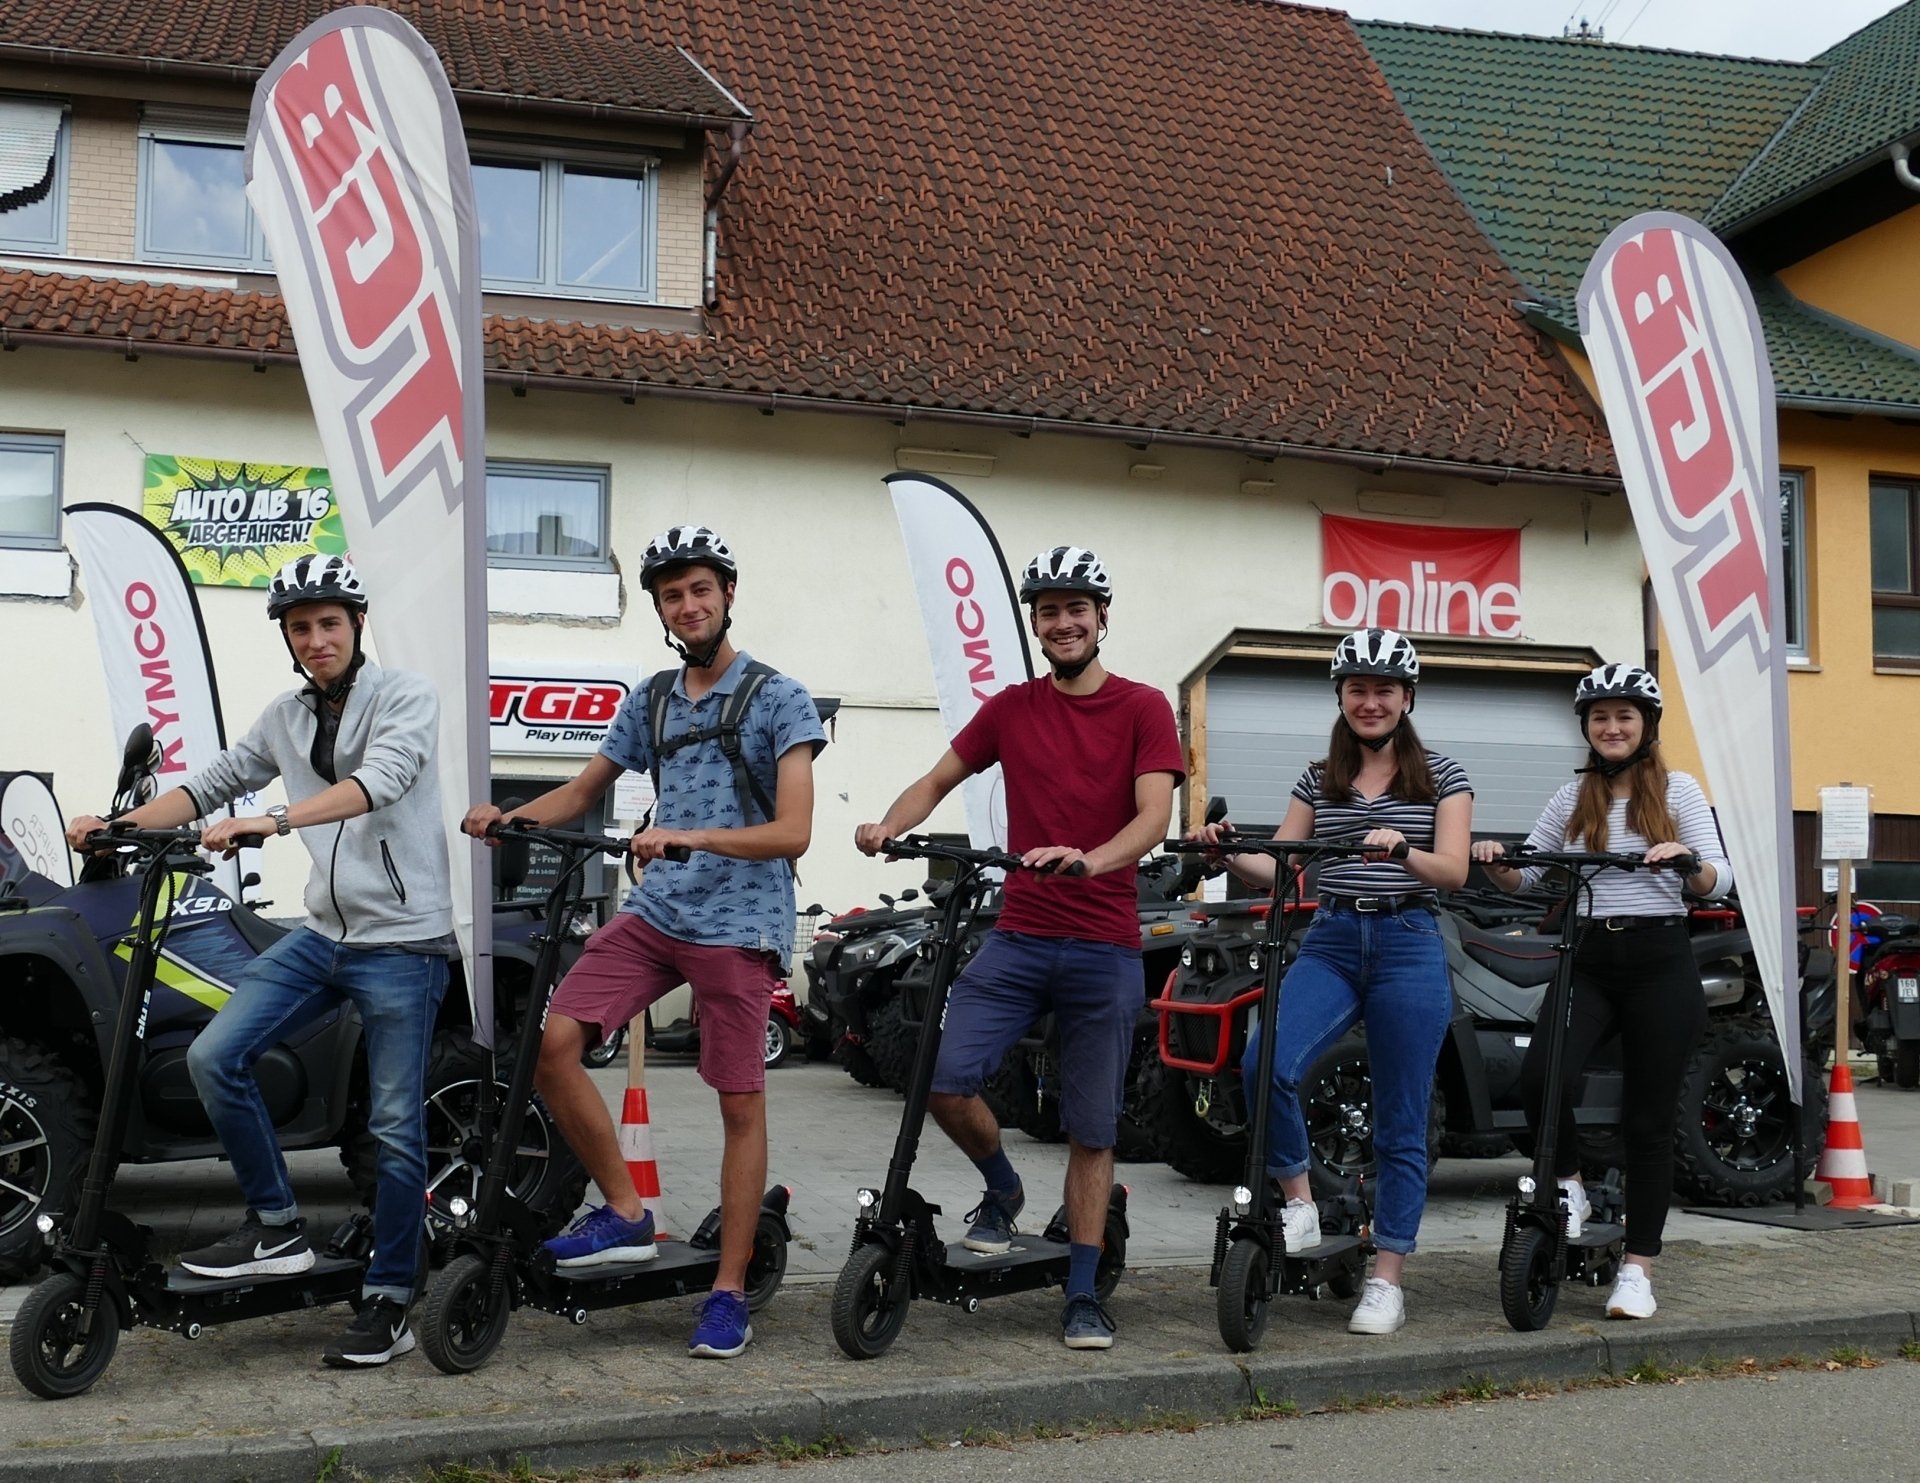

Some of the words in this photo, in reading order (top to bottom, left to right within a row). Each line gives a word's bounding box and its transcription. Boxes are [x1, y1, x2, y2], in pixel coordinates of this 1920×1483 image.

[170, 488, 247, 521] AUTO
[249, 488, 289, 521] AB
[296, 487, 330, 519] 16
[189, 521, 313, 545] ABGEFAHREN!
[1322, 560, 1521, 638] online
[489, 684, 622, 722] TGB
[525, 729, 560, 742] Play
[562, 730, 607, 742] Differ
